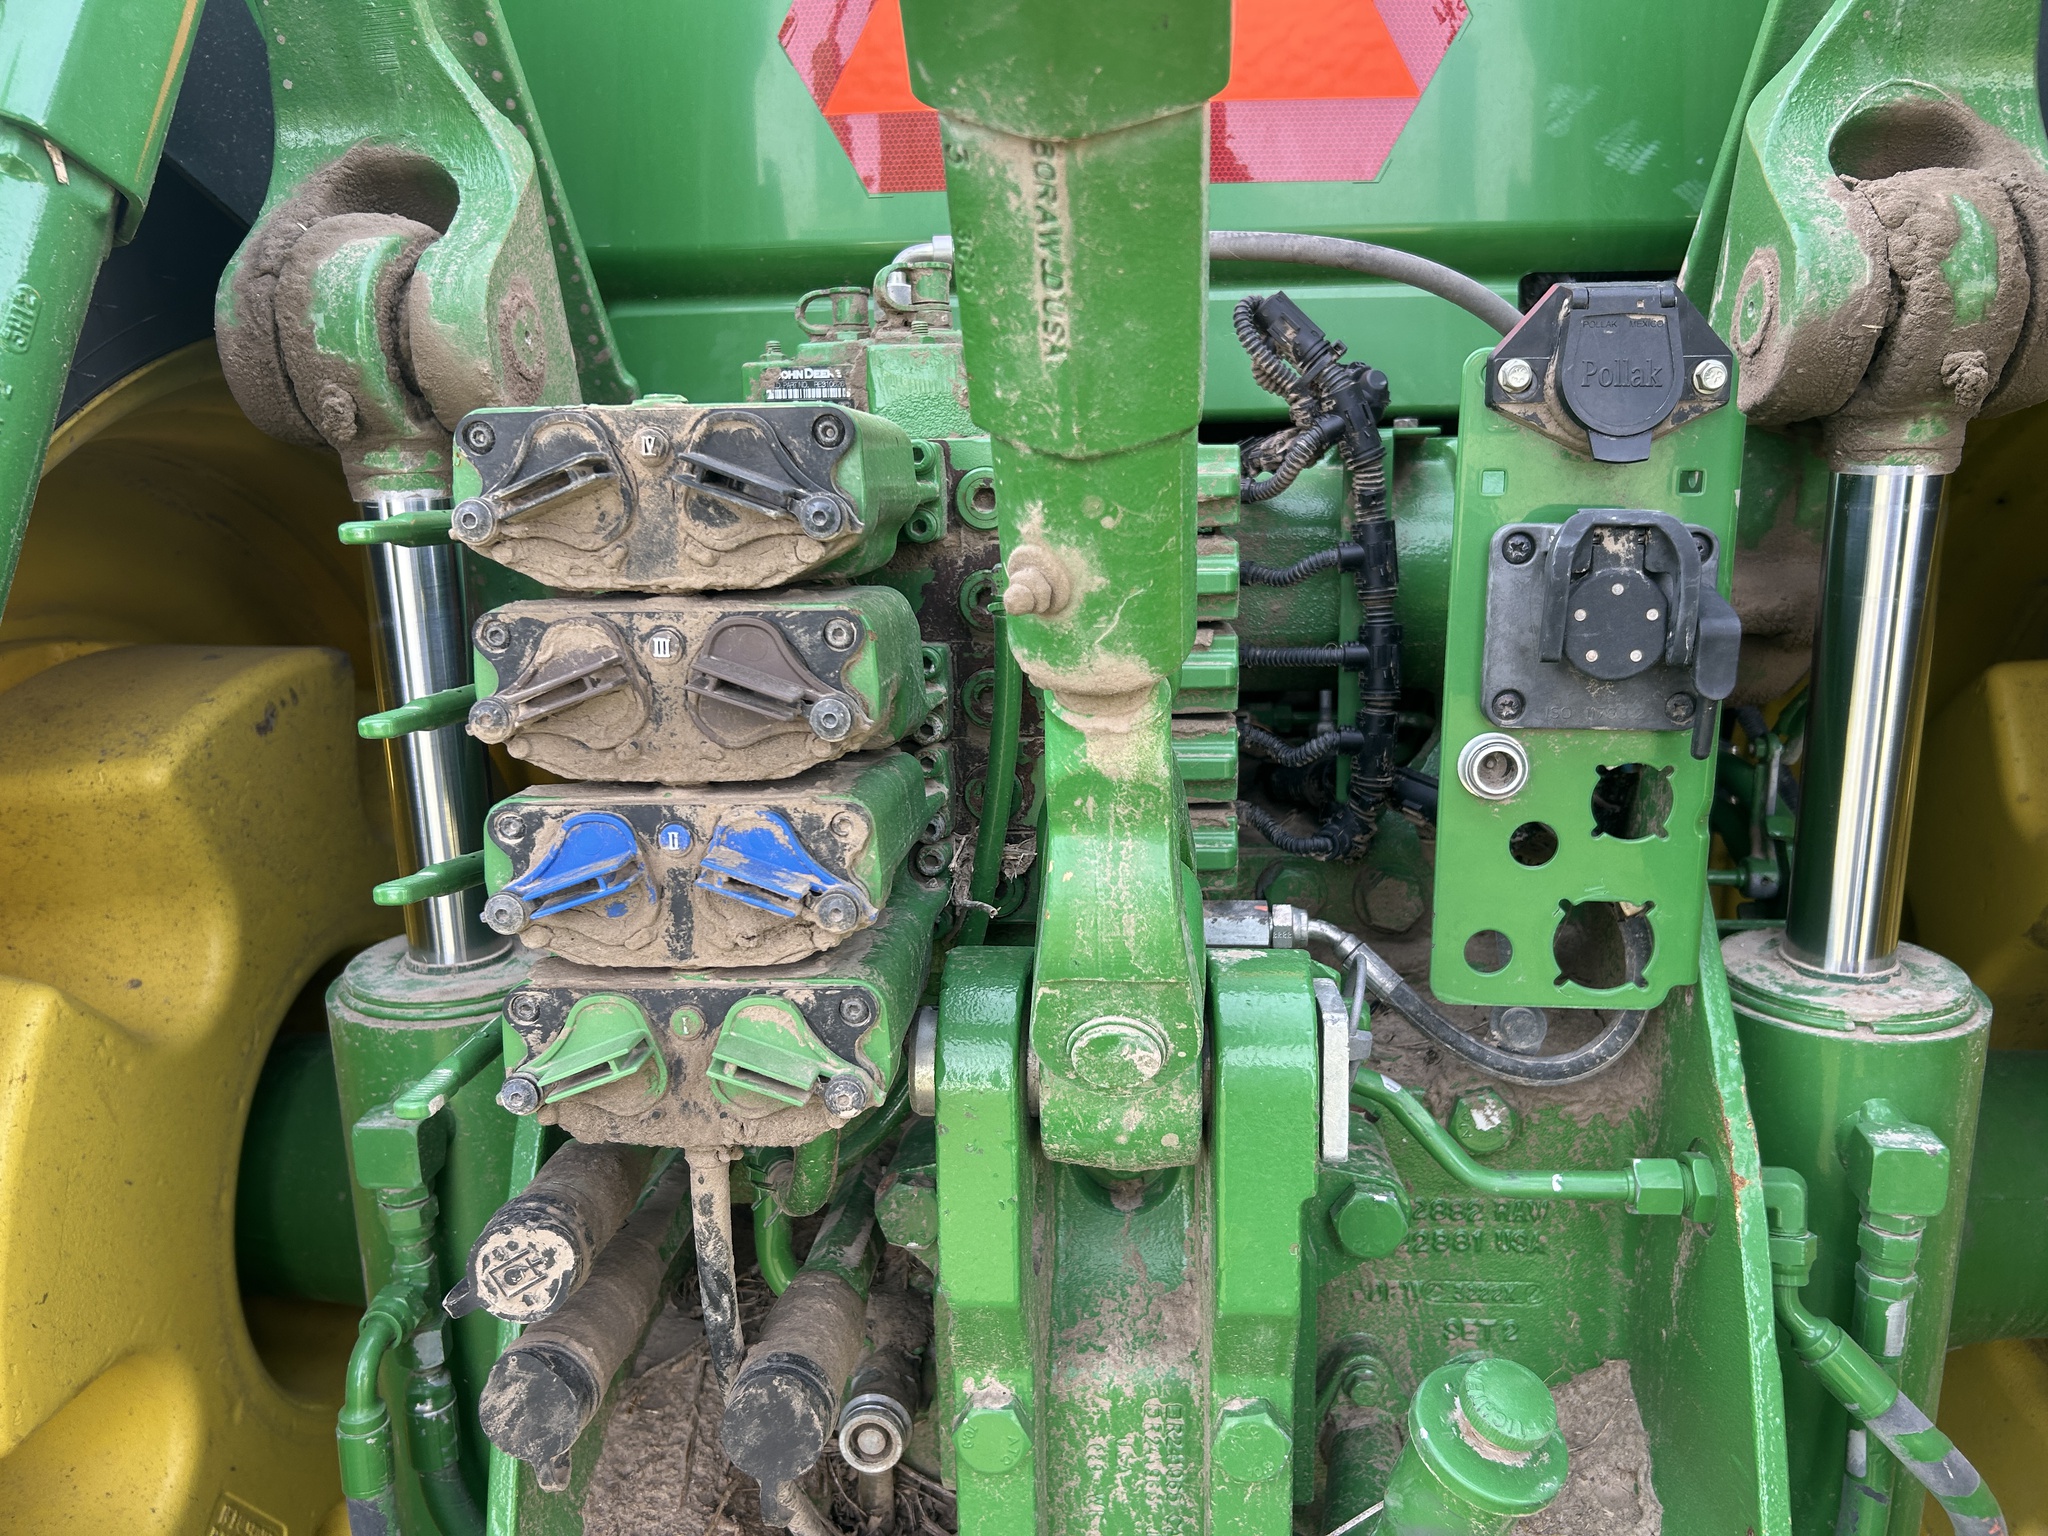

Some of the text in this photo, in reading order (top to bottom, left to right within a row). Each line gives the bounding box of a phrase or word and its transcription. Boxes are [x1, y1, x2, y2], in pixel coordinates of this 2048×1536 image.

[1582, 319, 1665, 329] POLLAK MEXICO
[1580, 358, 1663, 388] Pollak
[641, 435, 657, 456] IV
[652, 637, 671, 658] III
[667, 831, 681, 851] II
[1494, 1199, 1550, 1224] RAW
[1493, 1228, 1551, 1255] USA
[1442, 1317, 1520, 1343] SET 2
